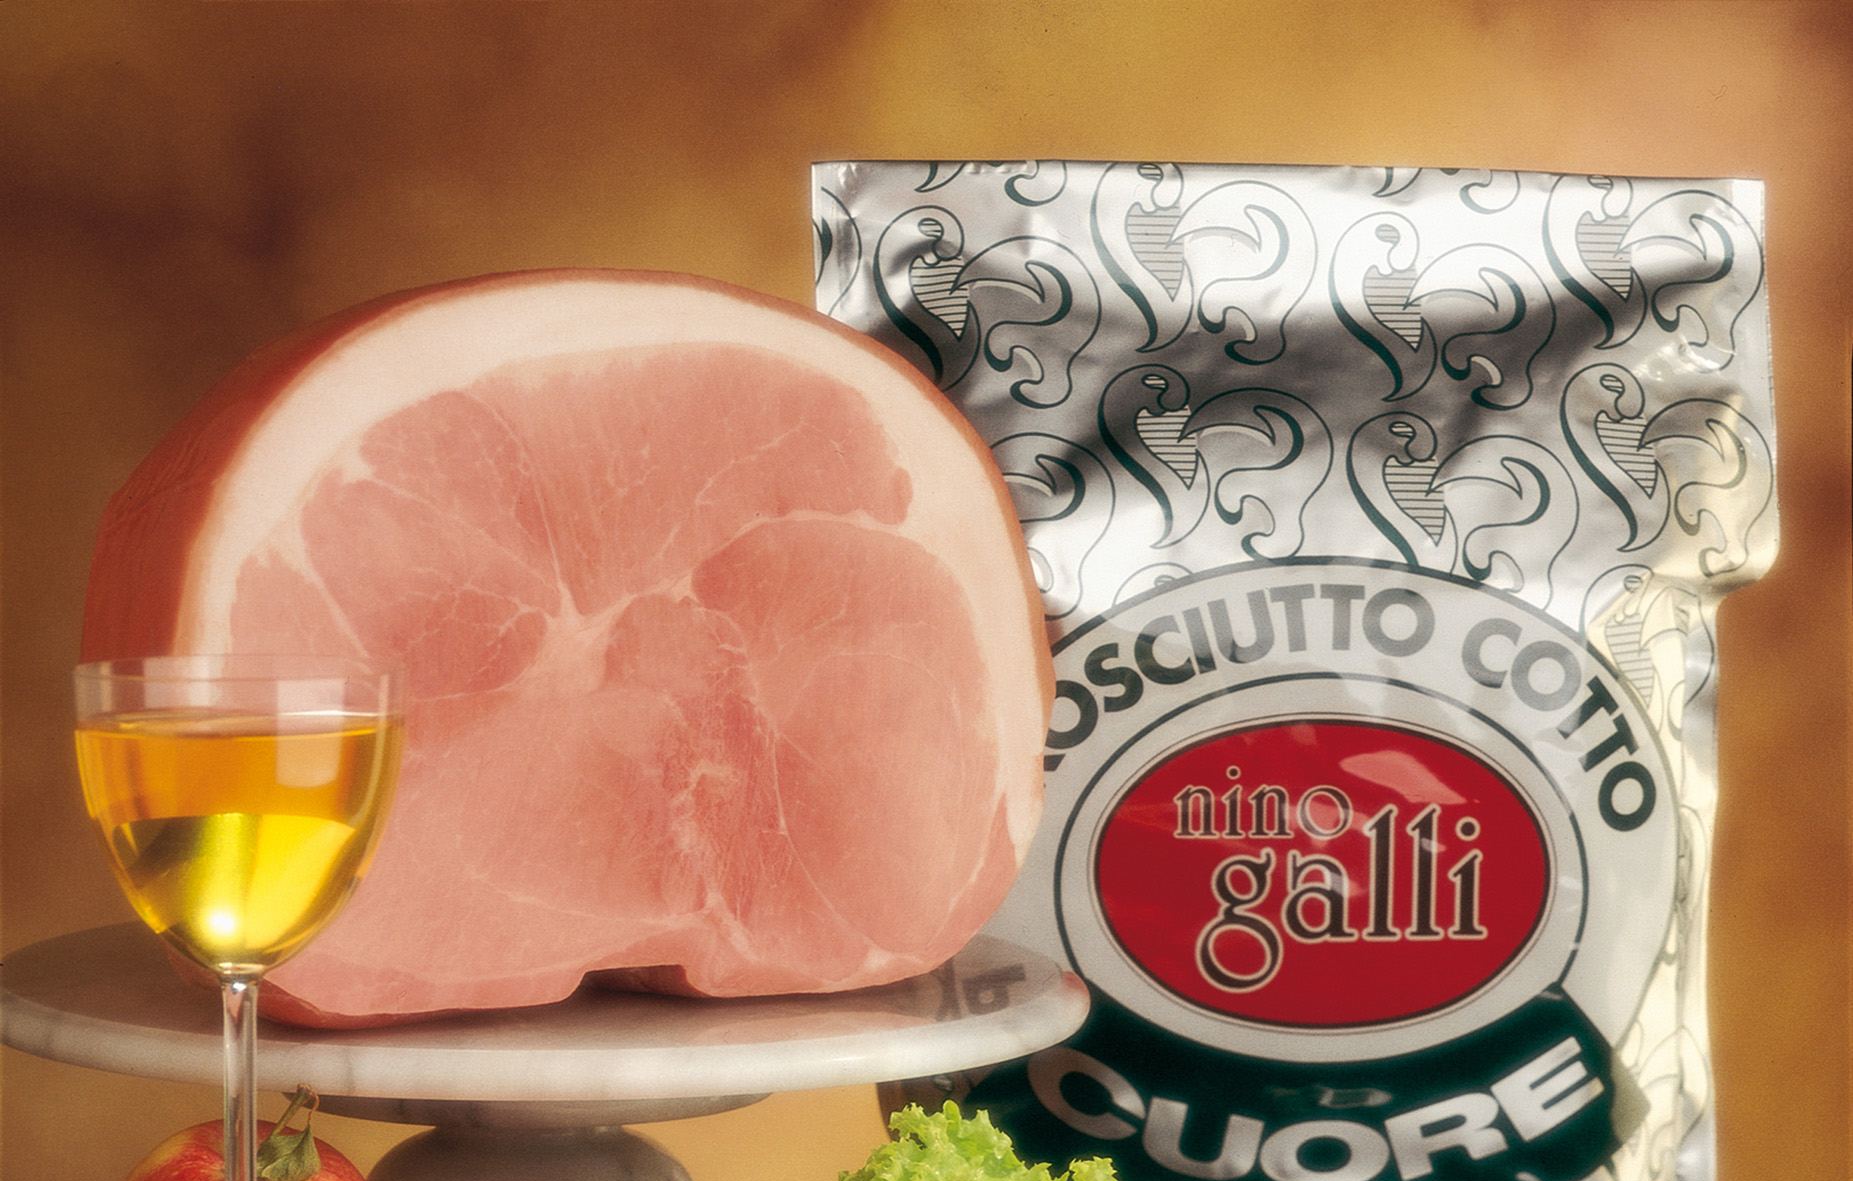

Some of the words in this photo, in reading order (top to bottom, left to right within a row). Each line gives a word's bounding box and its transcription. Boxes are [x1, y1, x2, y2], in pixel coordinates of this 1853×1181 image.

[1043, 583, 1435, 772] OSCIUTTO
[1461, 617, 1657, 832] COTTO
[1173, 765, 1353, 841] nino
[1195, 803, 1488, 994] galli
